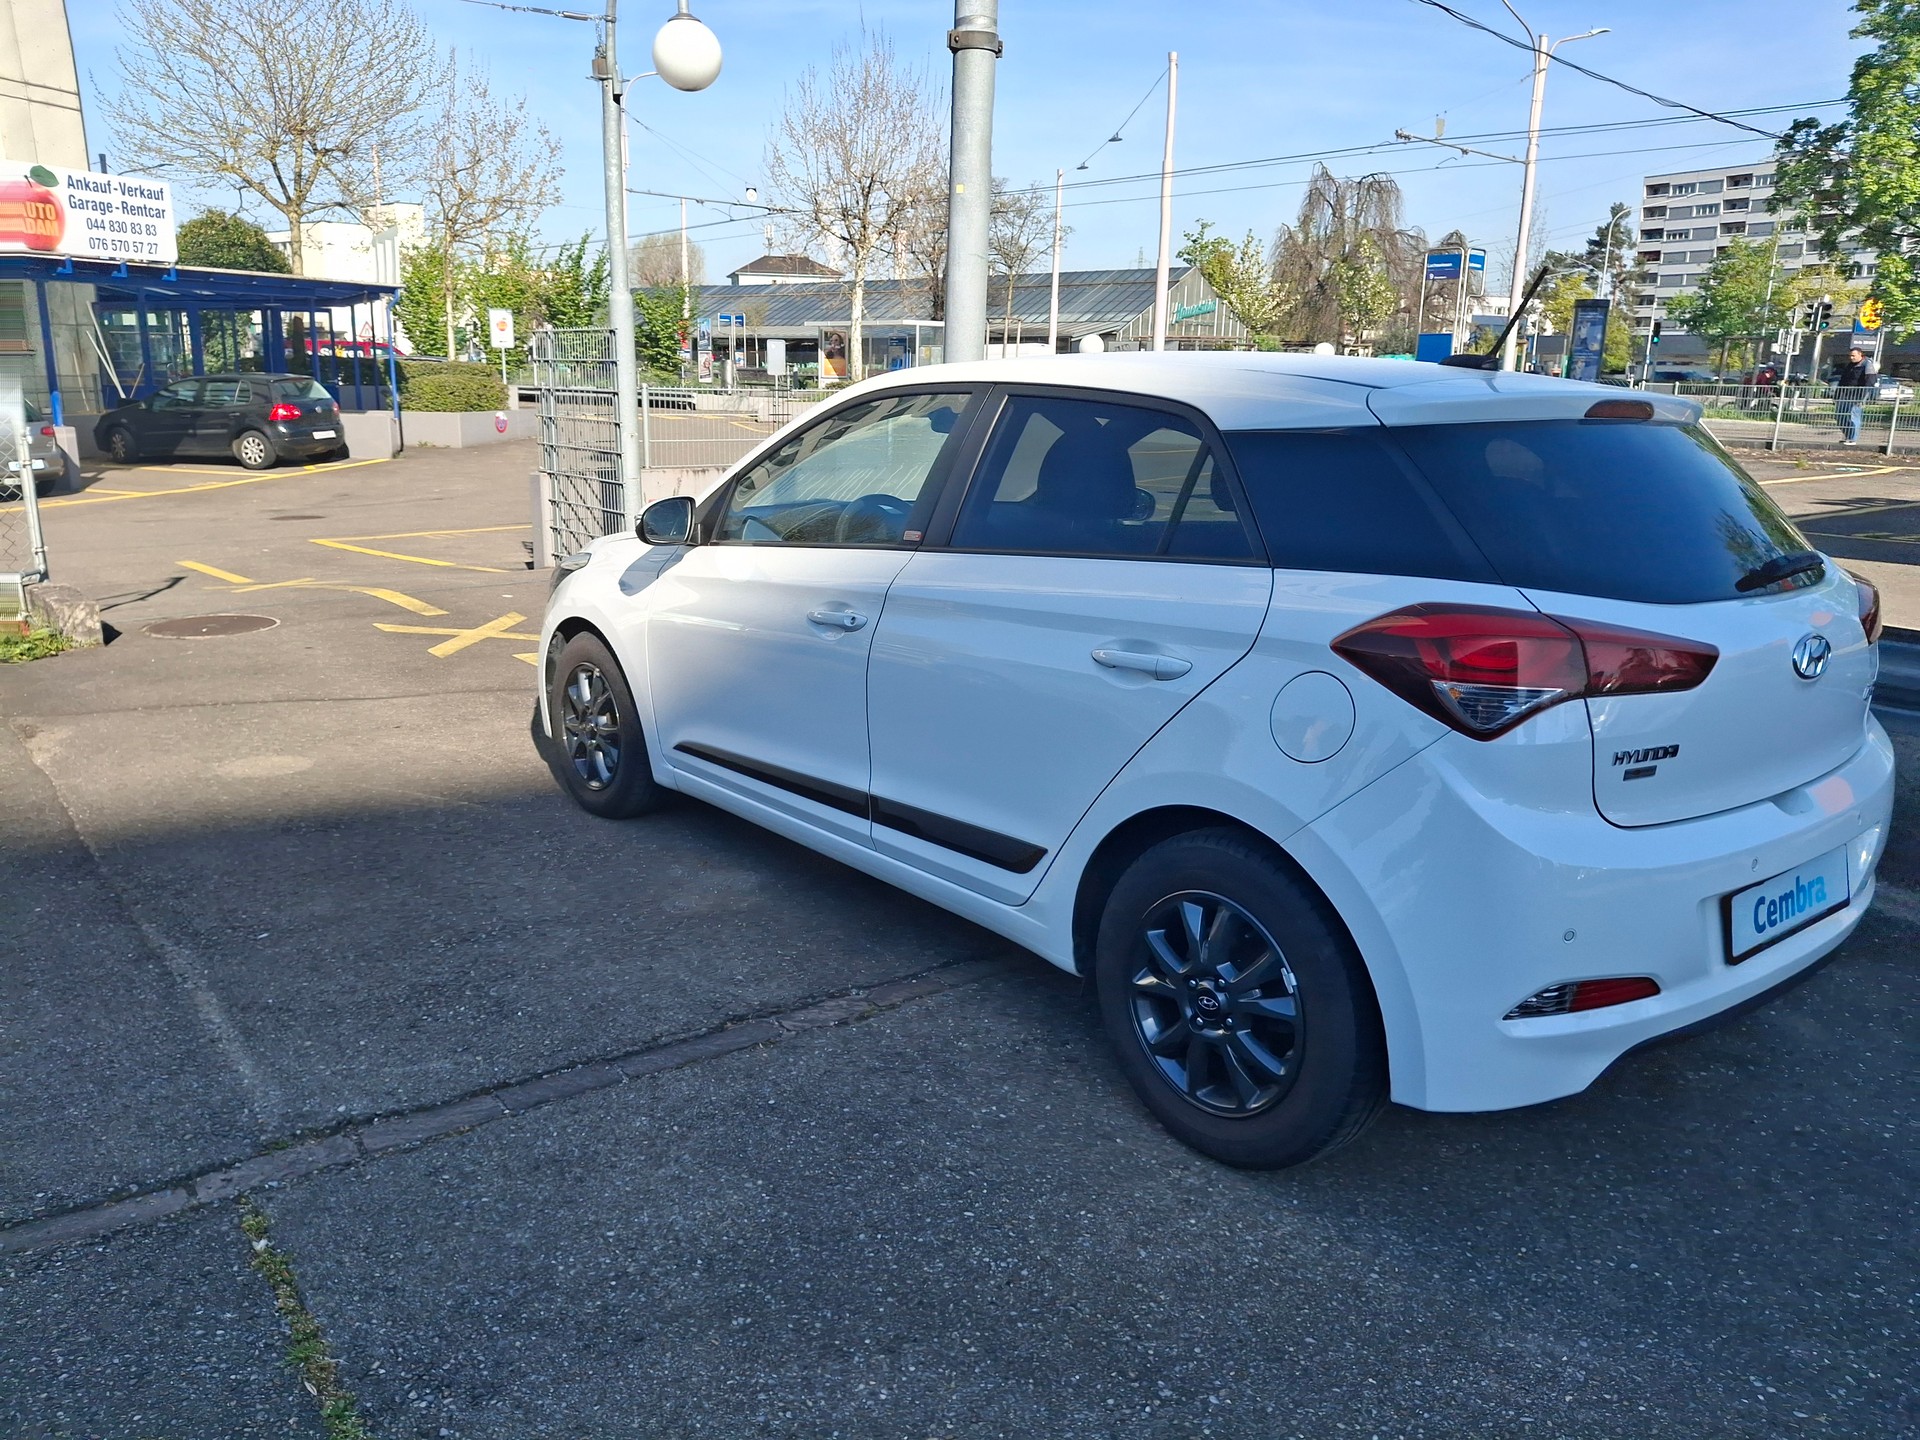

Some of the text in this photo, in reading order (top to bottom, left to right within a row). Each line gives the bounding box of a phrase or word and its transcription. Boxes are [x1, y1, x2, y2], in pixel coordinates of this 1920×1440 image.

[86, 217, 157, 237] 044 830 83 83
[88, 236, 159, 255] 076 570 57 27
[1753, 875, 1827, 934] Cembra
